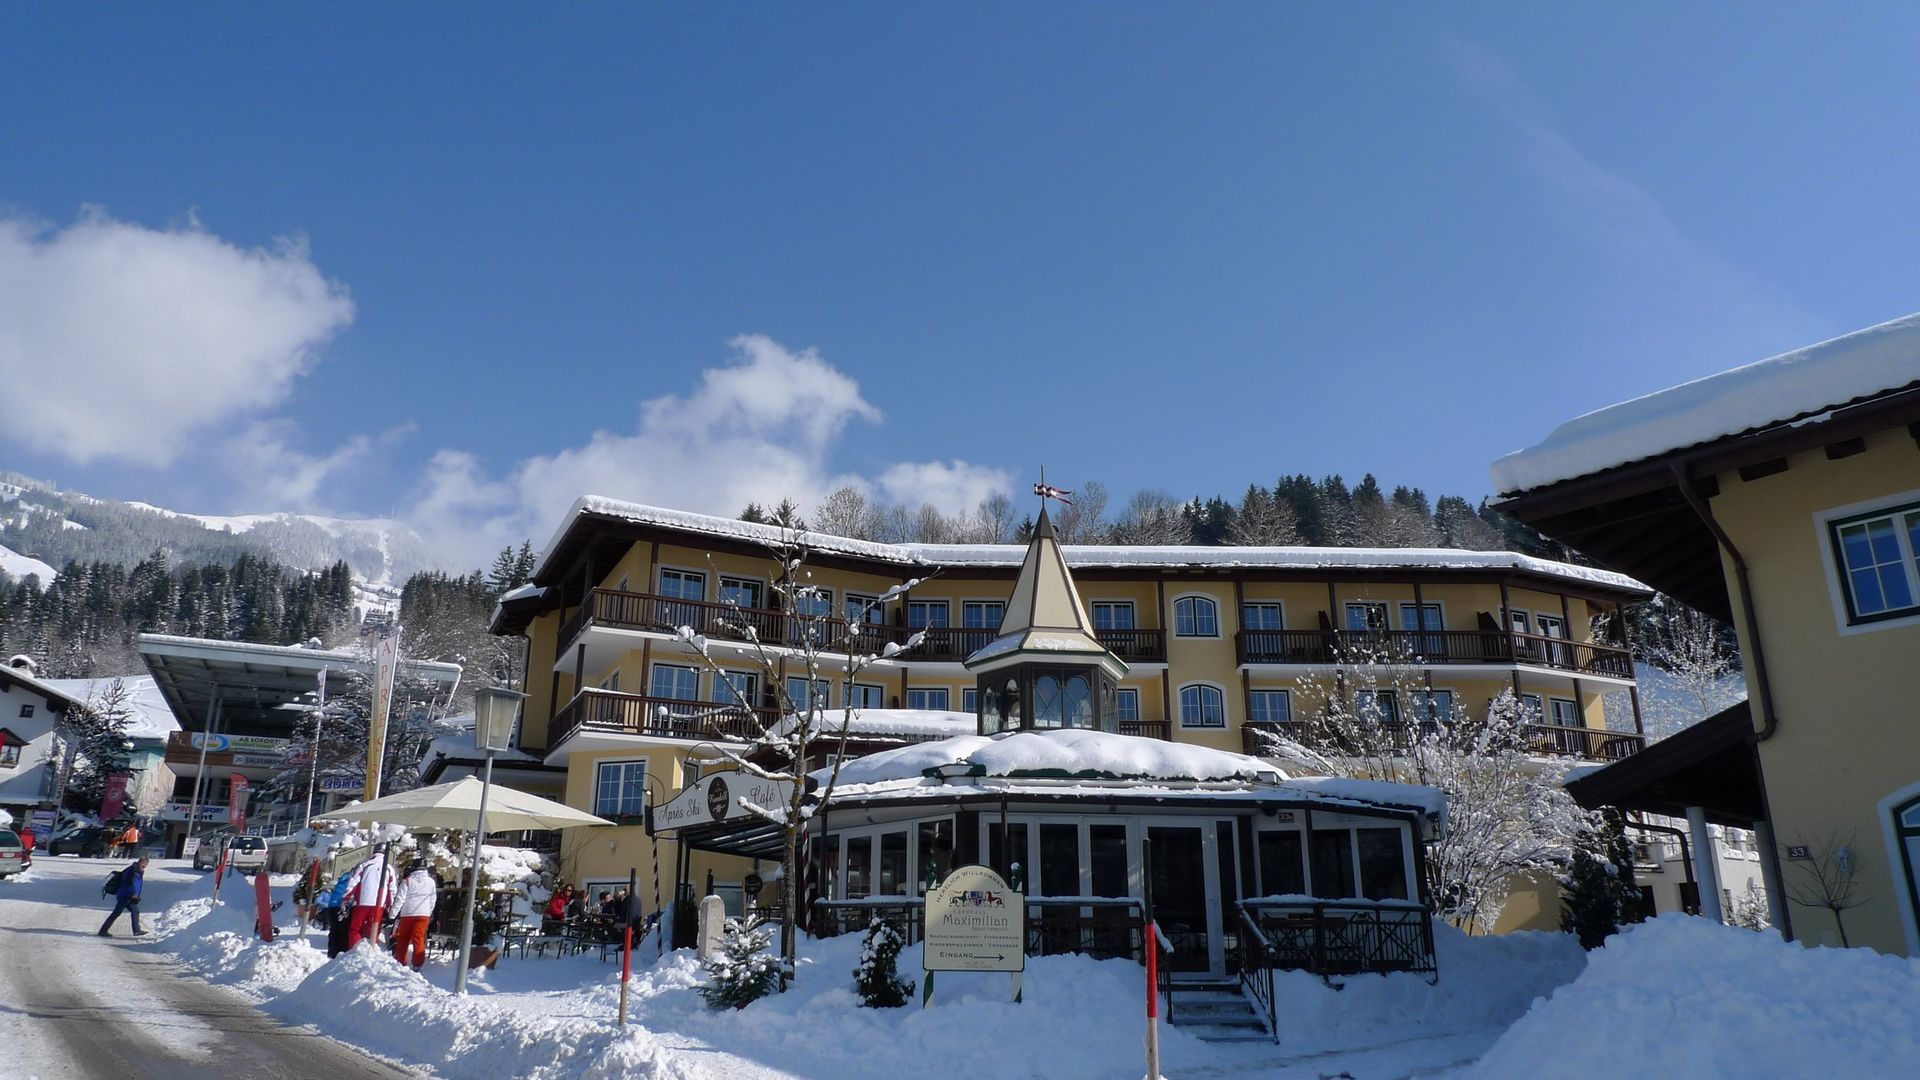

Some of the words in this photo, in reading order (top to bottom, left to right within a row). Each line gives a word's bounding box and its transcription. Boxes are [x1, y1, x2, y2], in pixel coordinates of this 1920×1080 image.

[750, 784, 776, 809] Café
[686, 799, 702, 818] Ski
[1791, 847, 1805, 857] 33
[943, 914, 1008, 926] Maximilian
